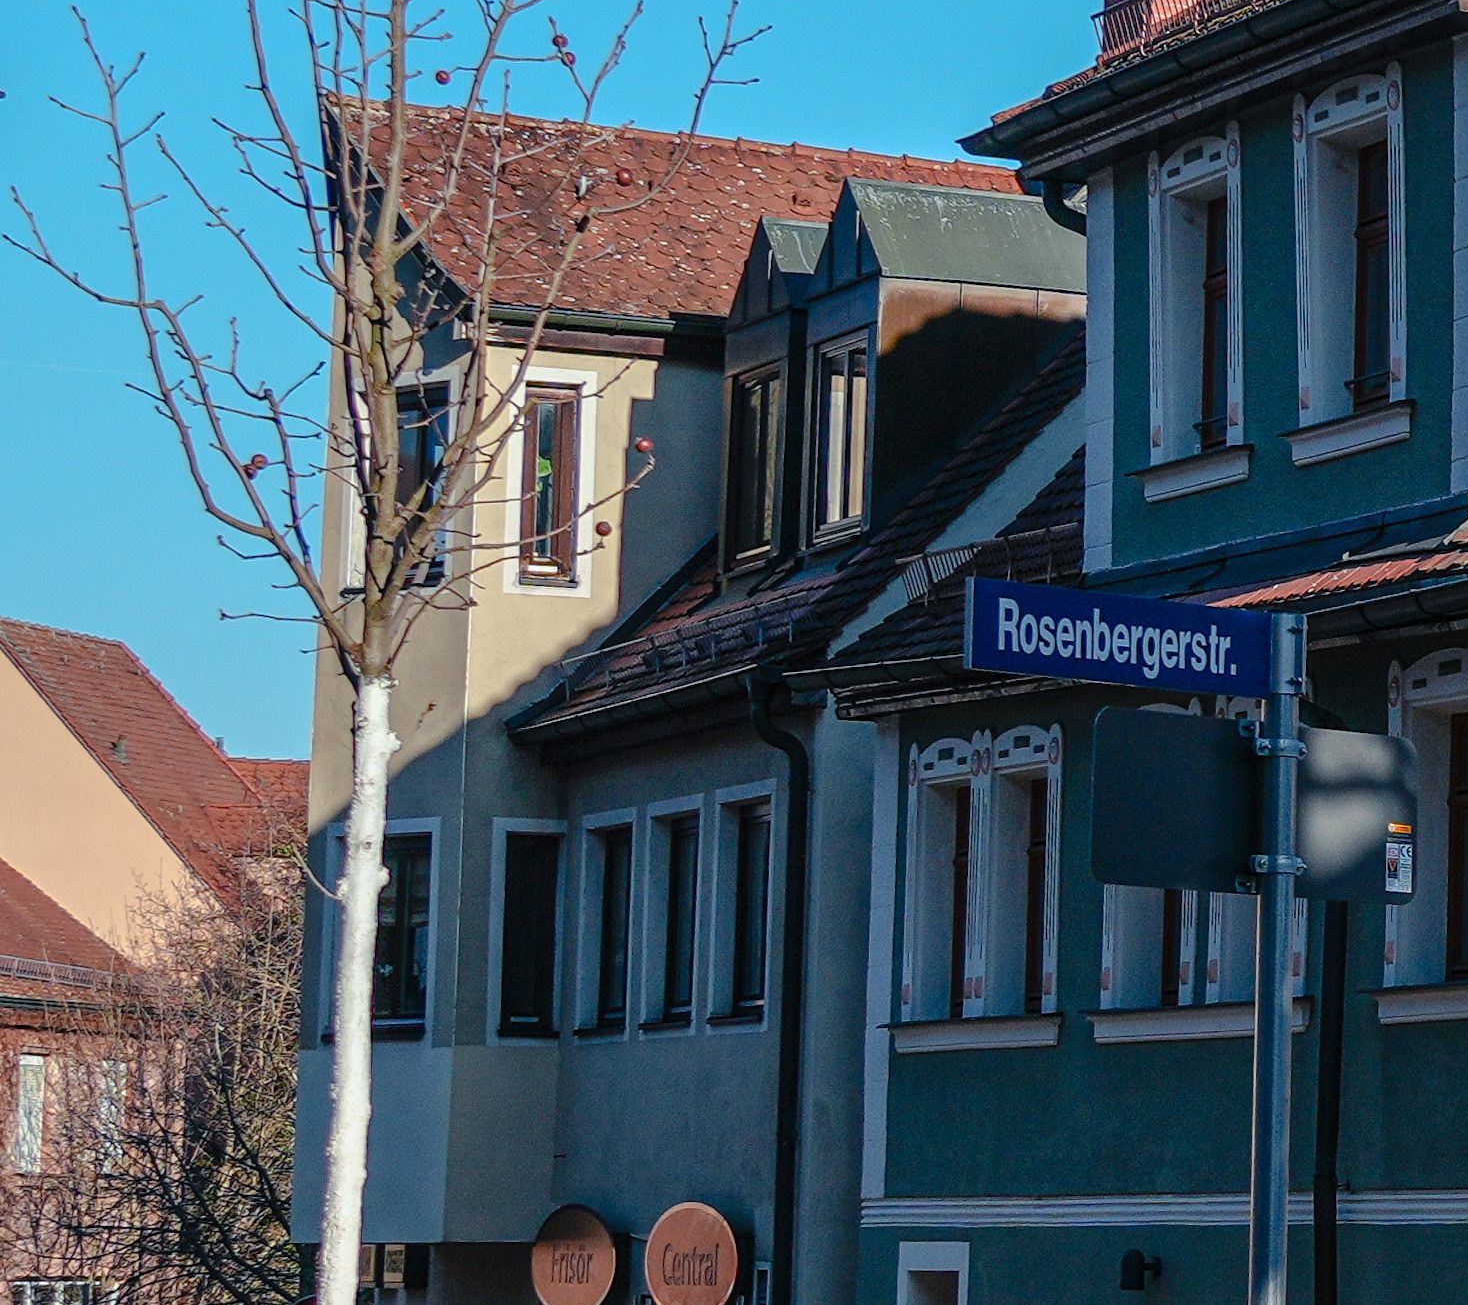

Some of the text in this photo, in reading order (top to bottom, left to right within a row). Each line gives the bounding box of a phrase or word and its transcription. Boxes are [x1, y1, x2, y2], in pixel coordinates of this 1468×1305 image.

[997, 597, 1237, 679] Rosenbergerstr.
[551, 1244, 594, 1285] Frisör
[662, 1243, 719, 1287] Central
